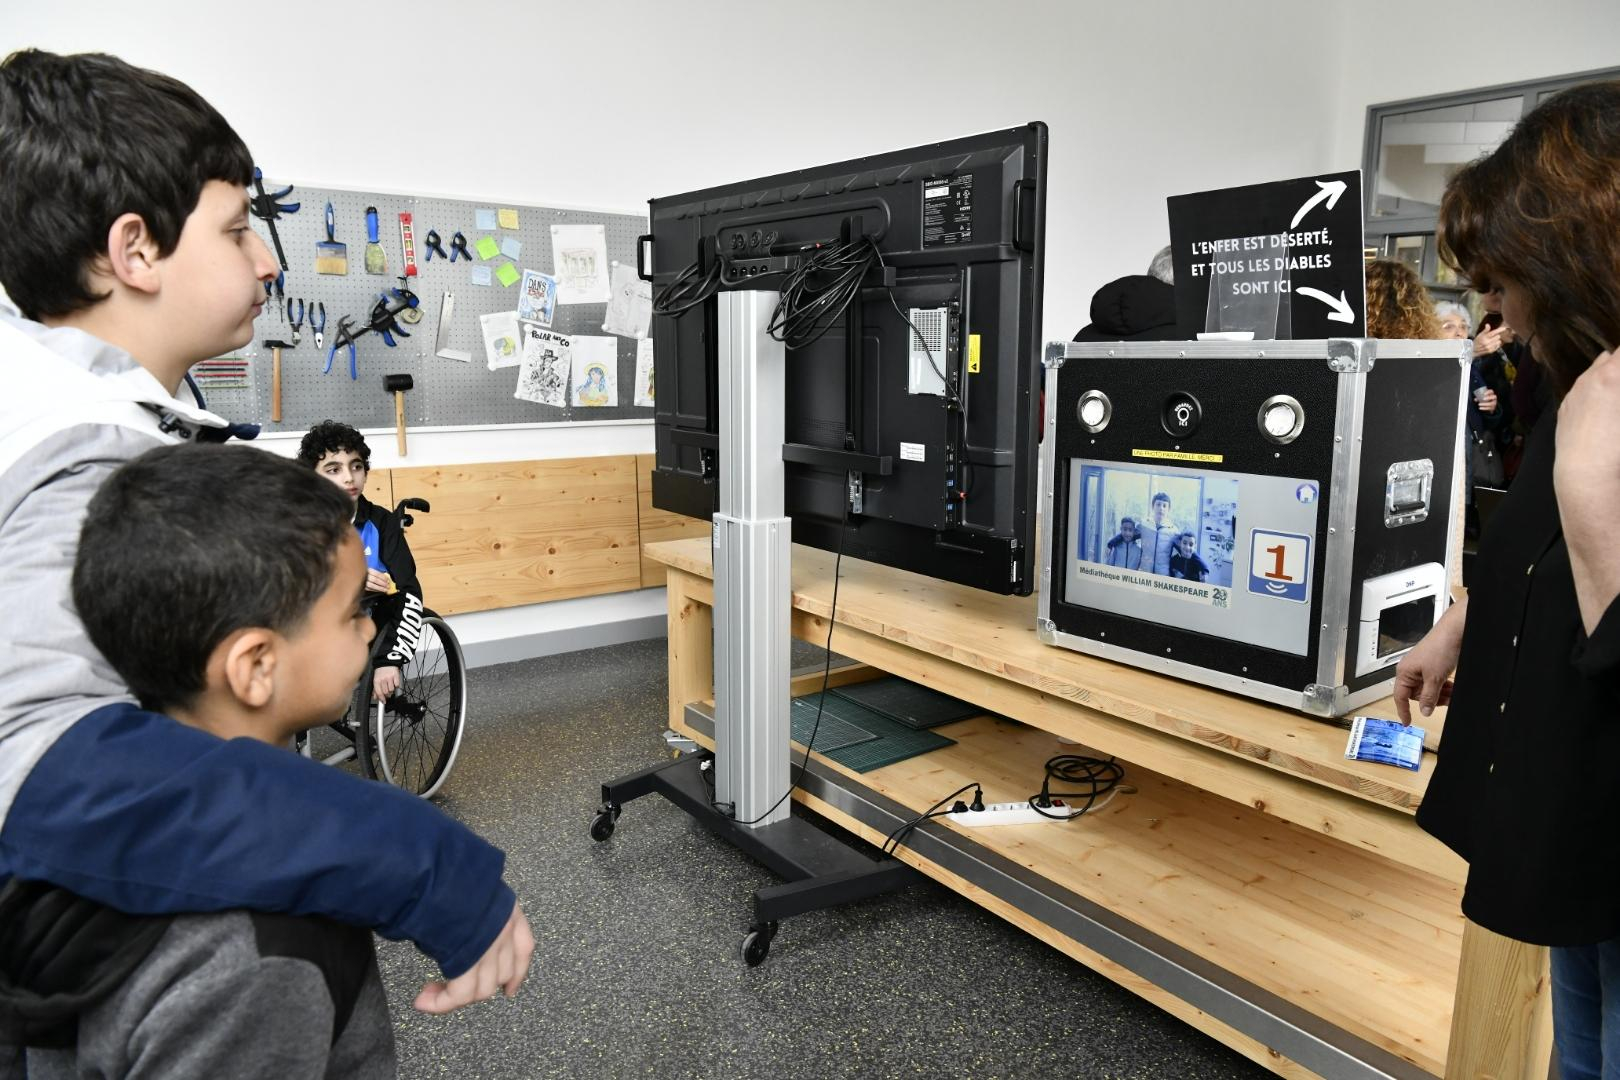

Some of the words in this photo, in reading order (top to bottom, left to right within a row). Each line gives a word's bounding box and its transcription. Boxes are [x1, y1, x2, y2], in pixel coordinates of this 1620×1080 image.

[1192, 238, 1240, 255] L'ENFER
[1243, 236, 1266, 250] EST
[1270, 227, 1333, 248] DÉSERTÉ,
[1191, 263, 1205, 276] ET
[1209, 260, 1244, 275] TOUS
[1249, 258, 1270, 272] LES
[1274, 254, 1332, 271] DIABLES
[1232, 281, 1269, 295] SONT
[1274, 279, 1291, 294] ICI
[1264, 544, 1293, 582] 1
[1121, 574, 1152, 587] WILLIAM
[1153, 580, 1209, 598] SHAKESPEARE
